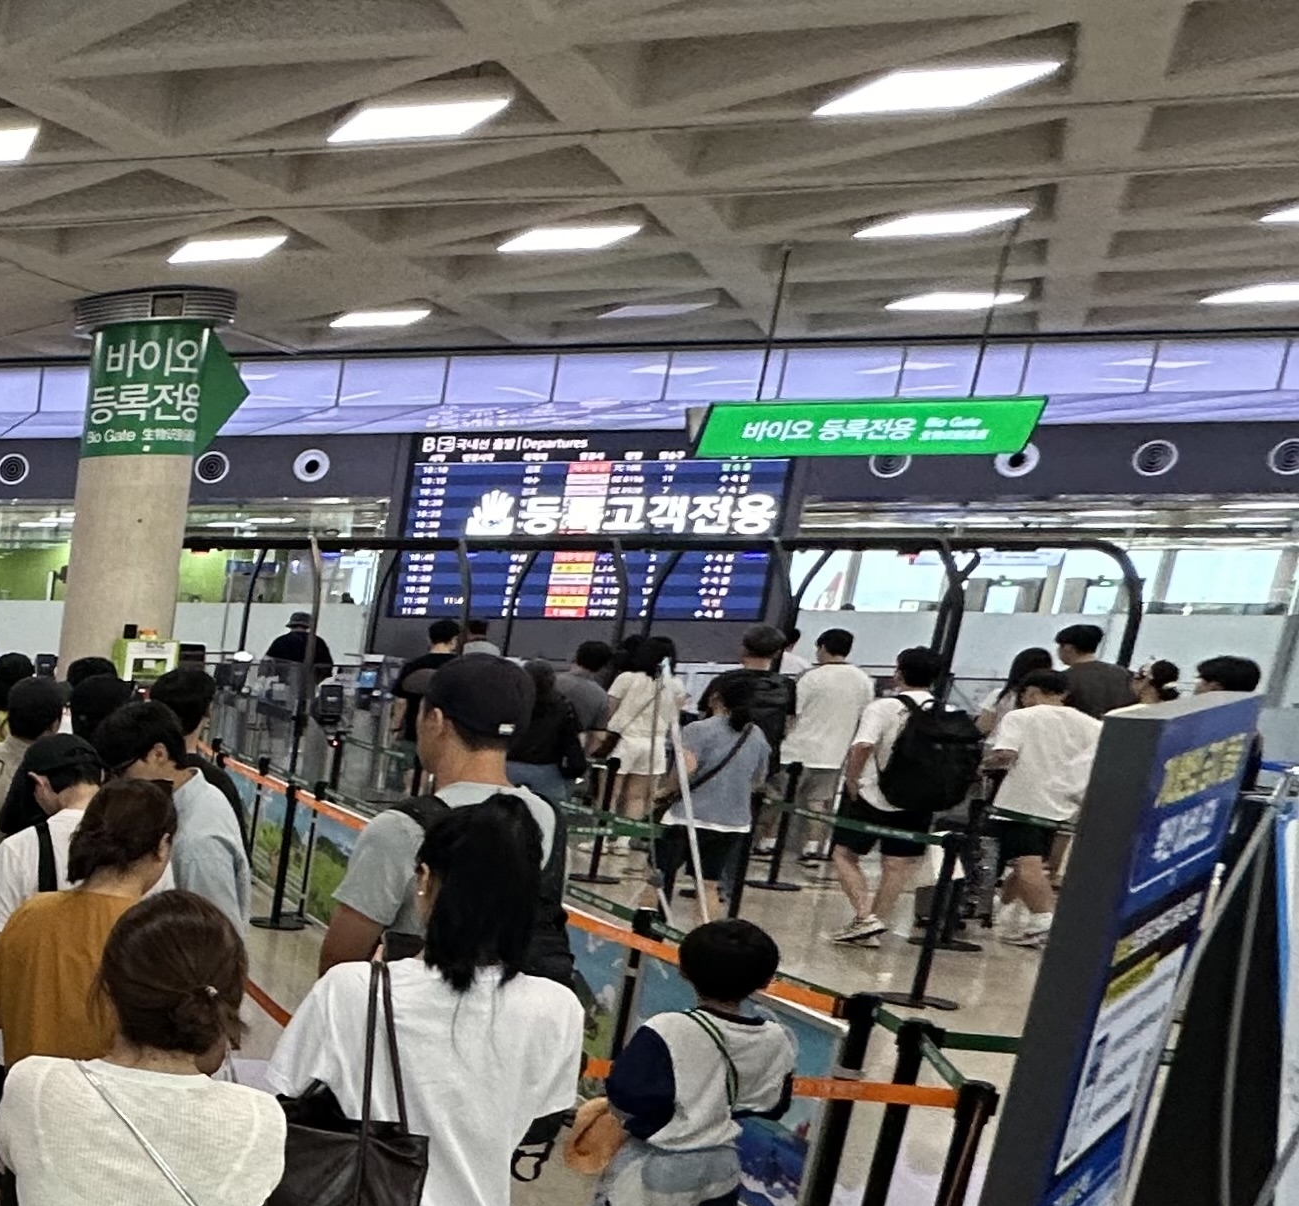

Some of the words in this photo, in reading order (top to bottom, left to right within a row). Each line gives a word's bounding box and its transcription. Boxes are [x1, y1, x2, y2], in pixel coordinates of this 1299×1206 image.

[106, 338, 199, 378] 바이오
[90, 383, 201, 424] 등록전용
[104, 429, 136, 443] Gate
[742, 420, 813, 442] 바이오
[818, 418, 917, 441] 등록전용
